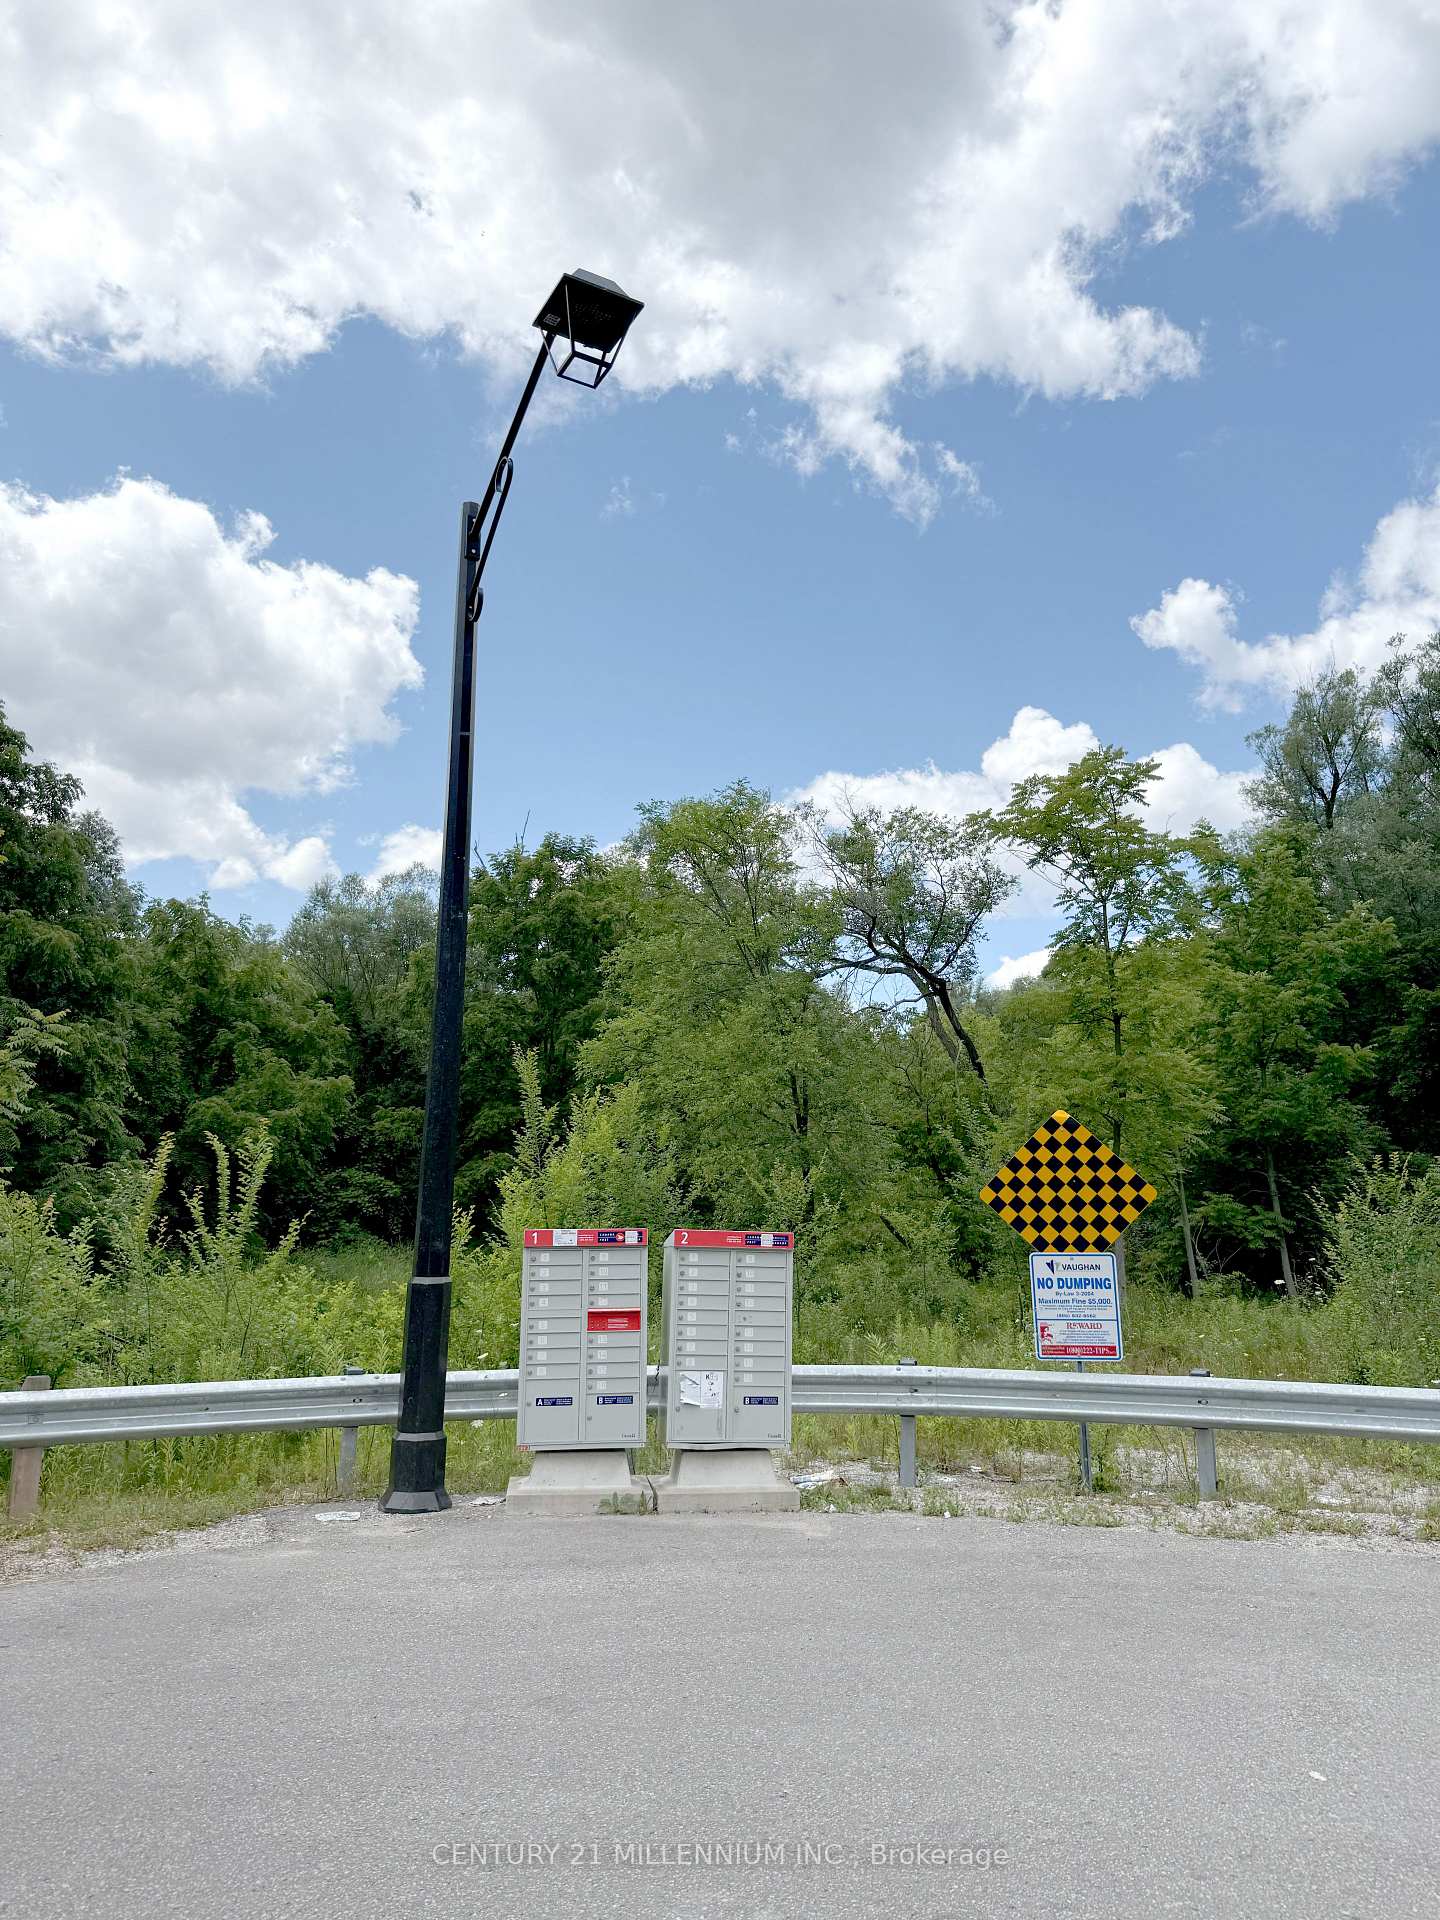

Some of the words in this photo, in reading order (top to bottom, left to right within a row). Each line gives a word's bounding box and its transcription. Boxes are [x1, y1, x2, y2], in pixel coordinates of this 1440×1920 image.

[531, 1231, 538, 1245] 1
[680, 1231, 689, 1244] 2
[1061, 1263, 1101, 1271] VAUGHAN
[1036, 1277, 1054, 1290] NO
[1057, 1277, 1112, 1290] DUMPING
[1038, 1297, 1070, 1305] Maximum
[1071, 1297, 1087, 1305] Fine
[537, 1398, 543, 1406] A
[744, 1397, 750, 1405] B
